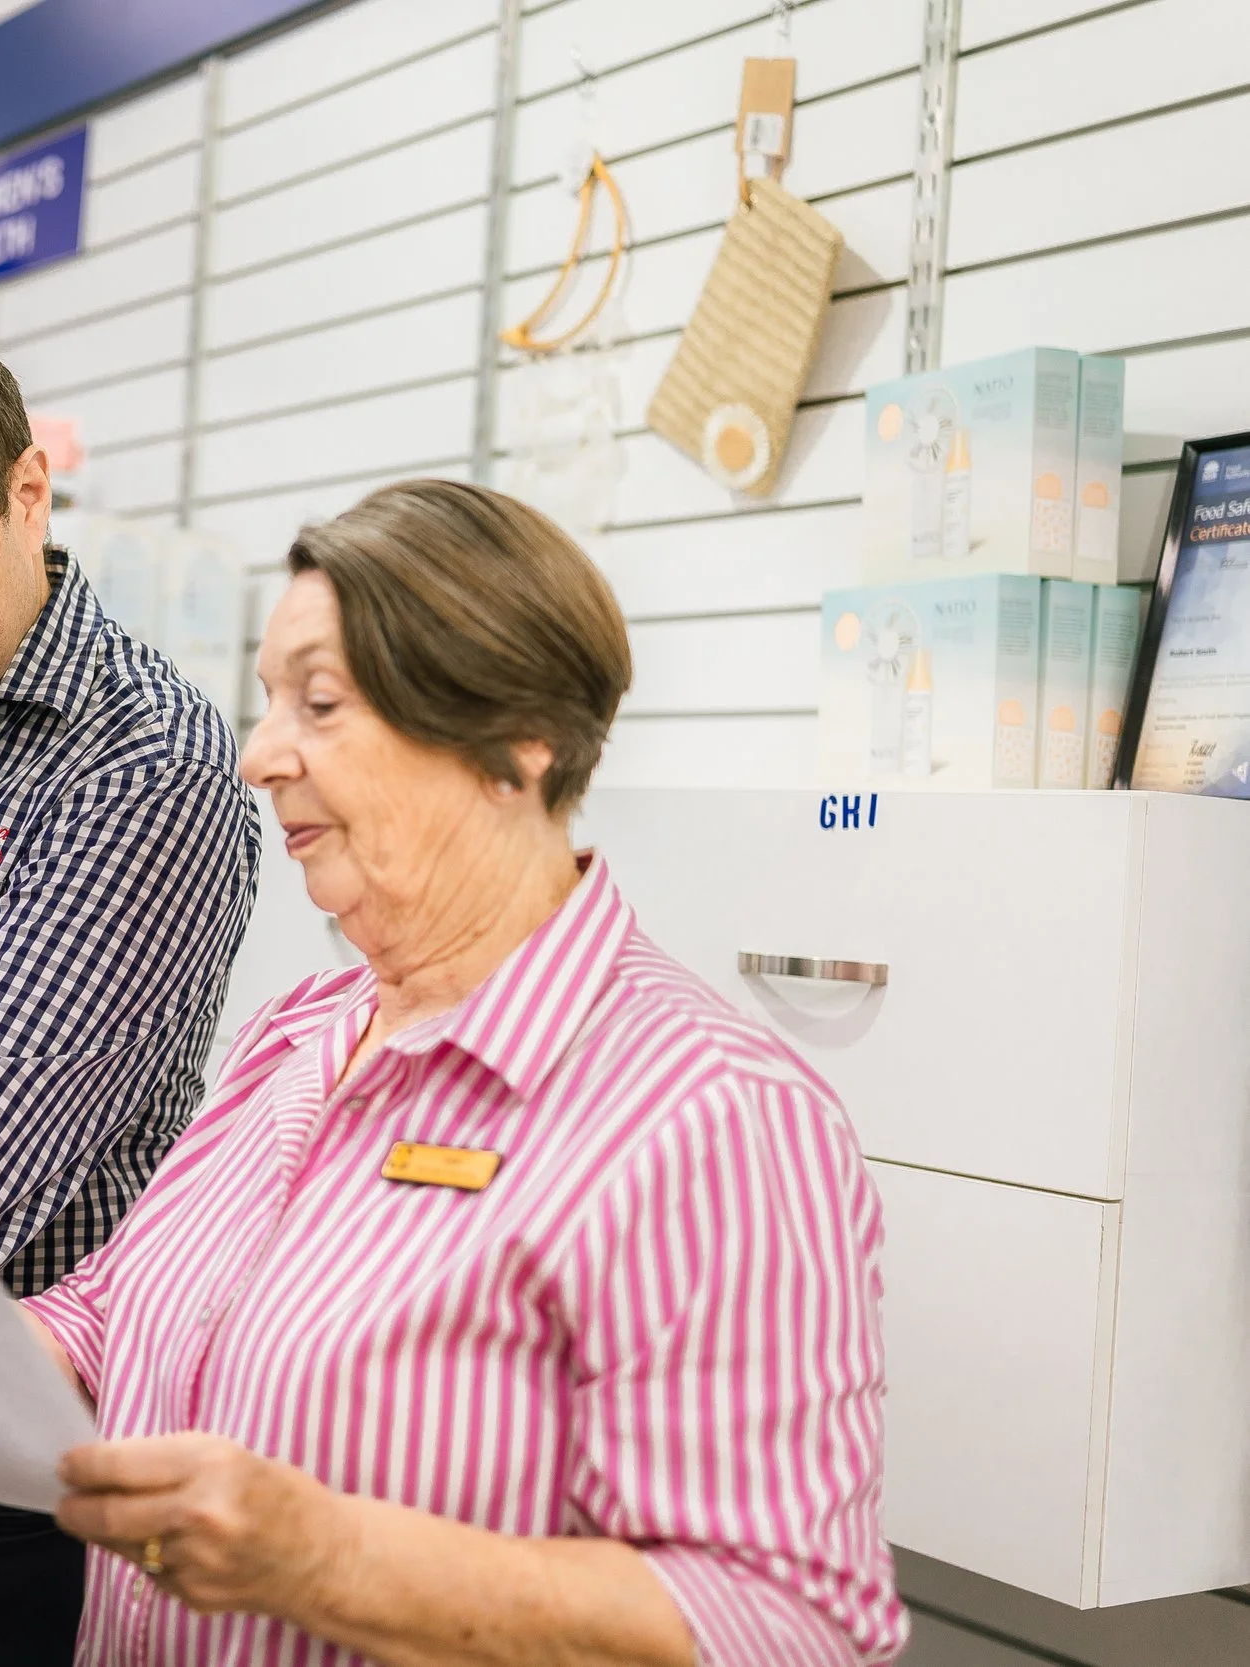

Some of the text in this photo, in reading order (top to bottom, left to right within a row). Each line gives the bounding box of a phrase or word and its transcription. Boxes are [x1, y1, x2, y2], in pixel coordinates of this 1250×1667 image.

[1194, 501, 1226, 521] Food
[934, 599, 977, 616] NATIO
[820, 793, 878, 829] GHI
